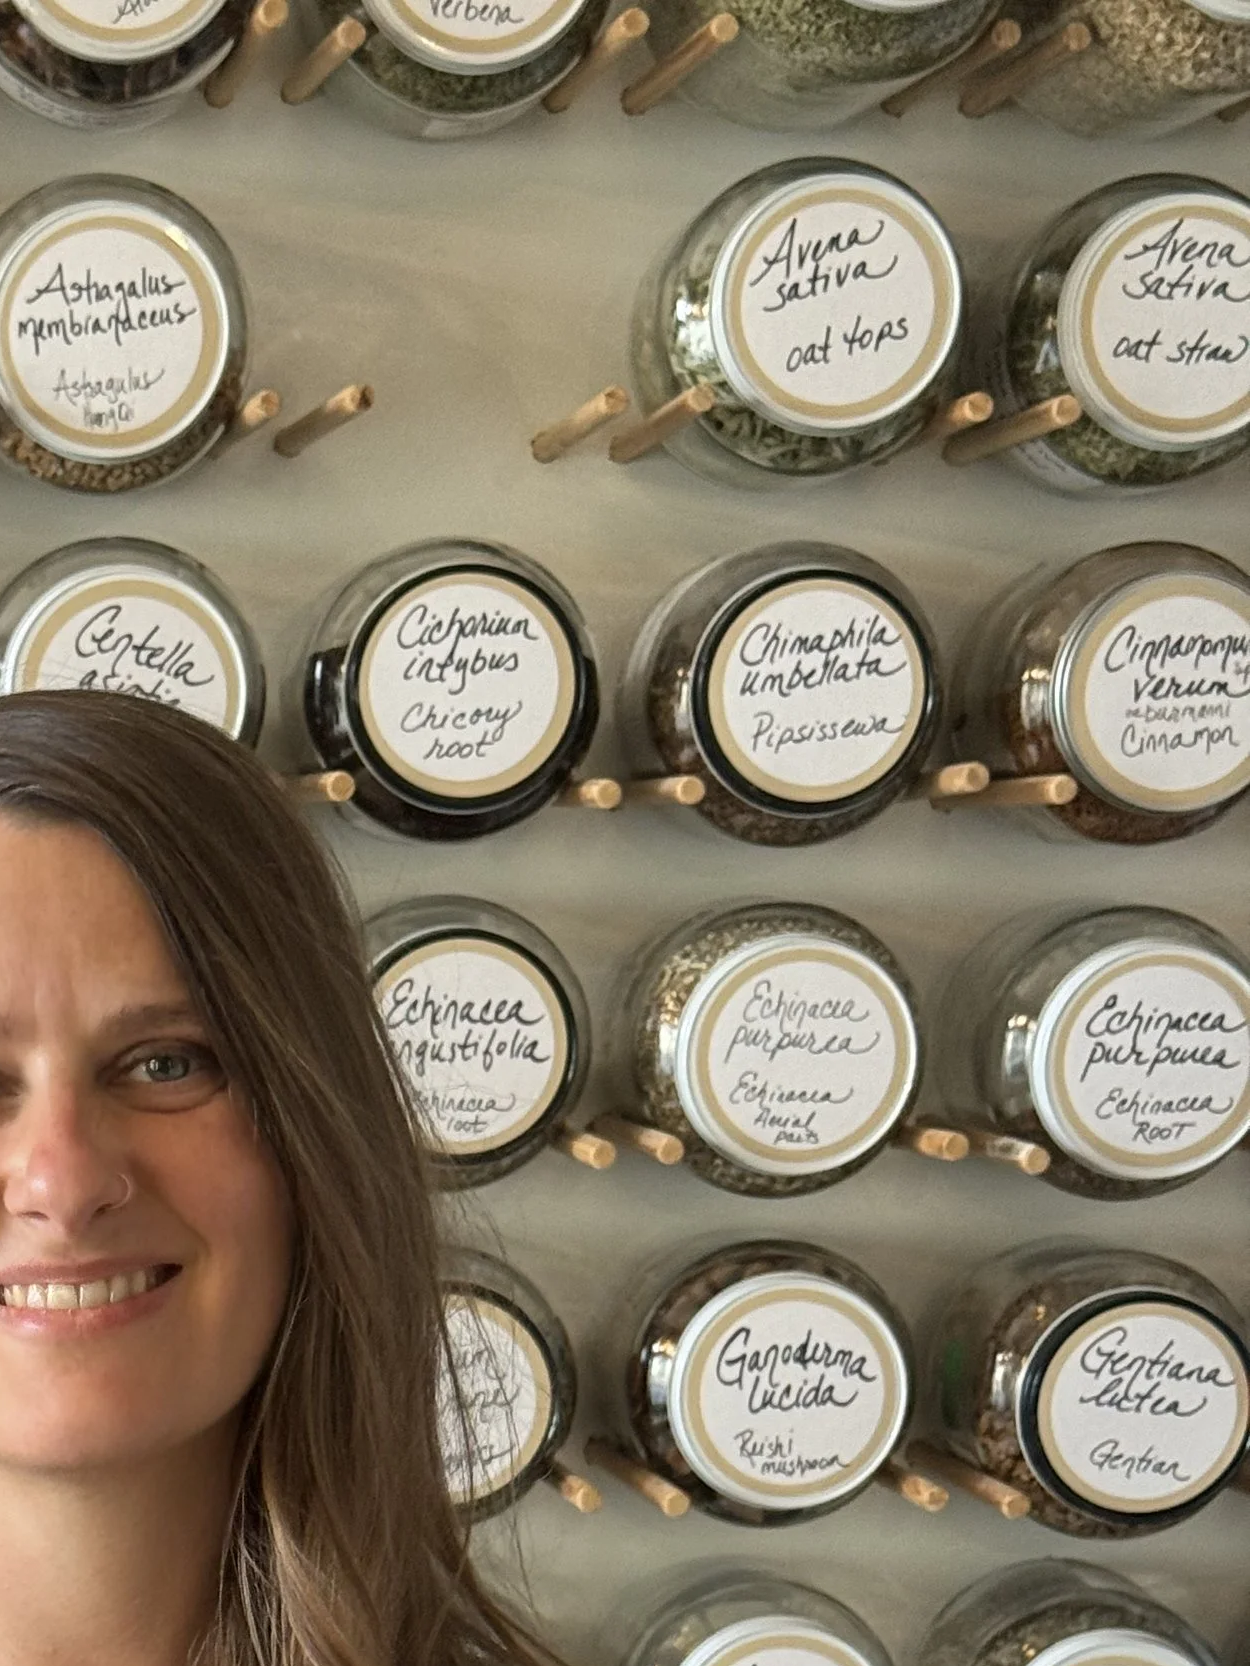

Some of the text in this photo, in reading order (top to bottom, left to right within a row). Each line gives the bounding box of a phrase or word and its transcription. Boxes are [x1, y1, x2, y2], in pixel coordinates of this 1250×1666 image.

[787, 315, 908, 372] oat tops
[1113, 329, 1249, 364] oat straw
[75, 604, 214, 687] Centella
[404, 648, 519, 694] intybus
[1104, 625, 1250, 673] Cinnamomu
[1121, 723, 1239, 758] Cinnamon
[386, 979, 546, 1035] Echinacea
[742, 979, 870, 1033] Echinacea
[1085, 995, 1250, 1046] Echinacea
[1095, 1087, 1234, 1121] Echinacea
[716, 1327, 878, 1389] Ganoderma
[1079, 1325, 1236, 1388] Gentiana
[1089, 1439, 1191, 1482] Gentian
